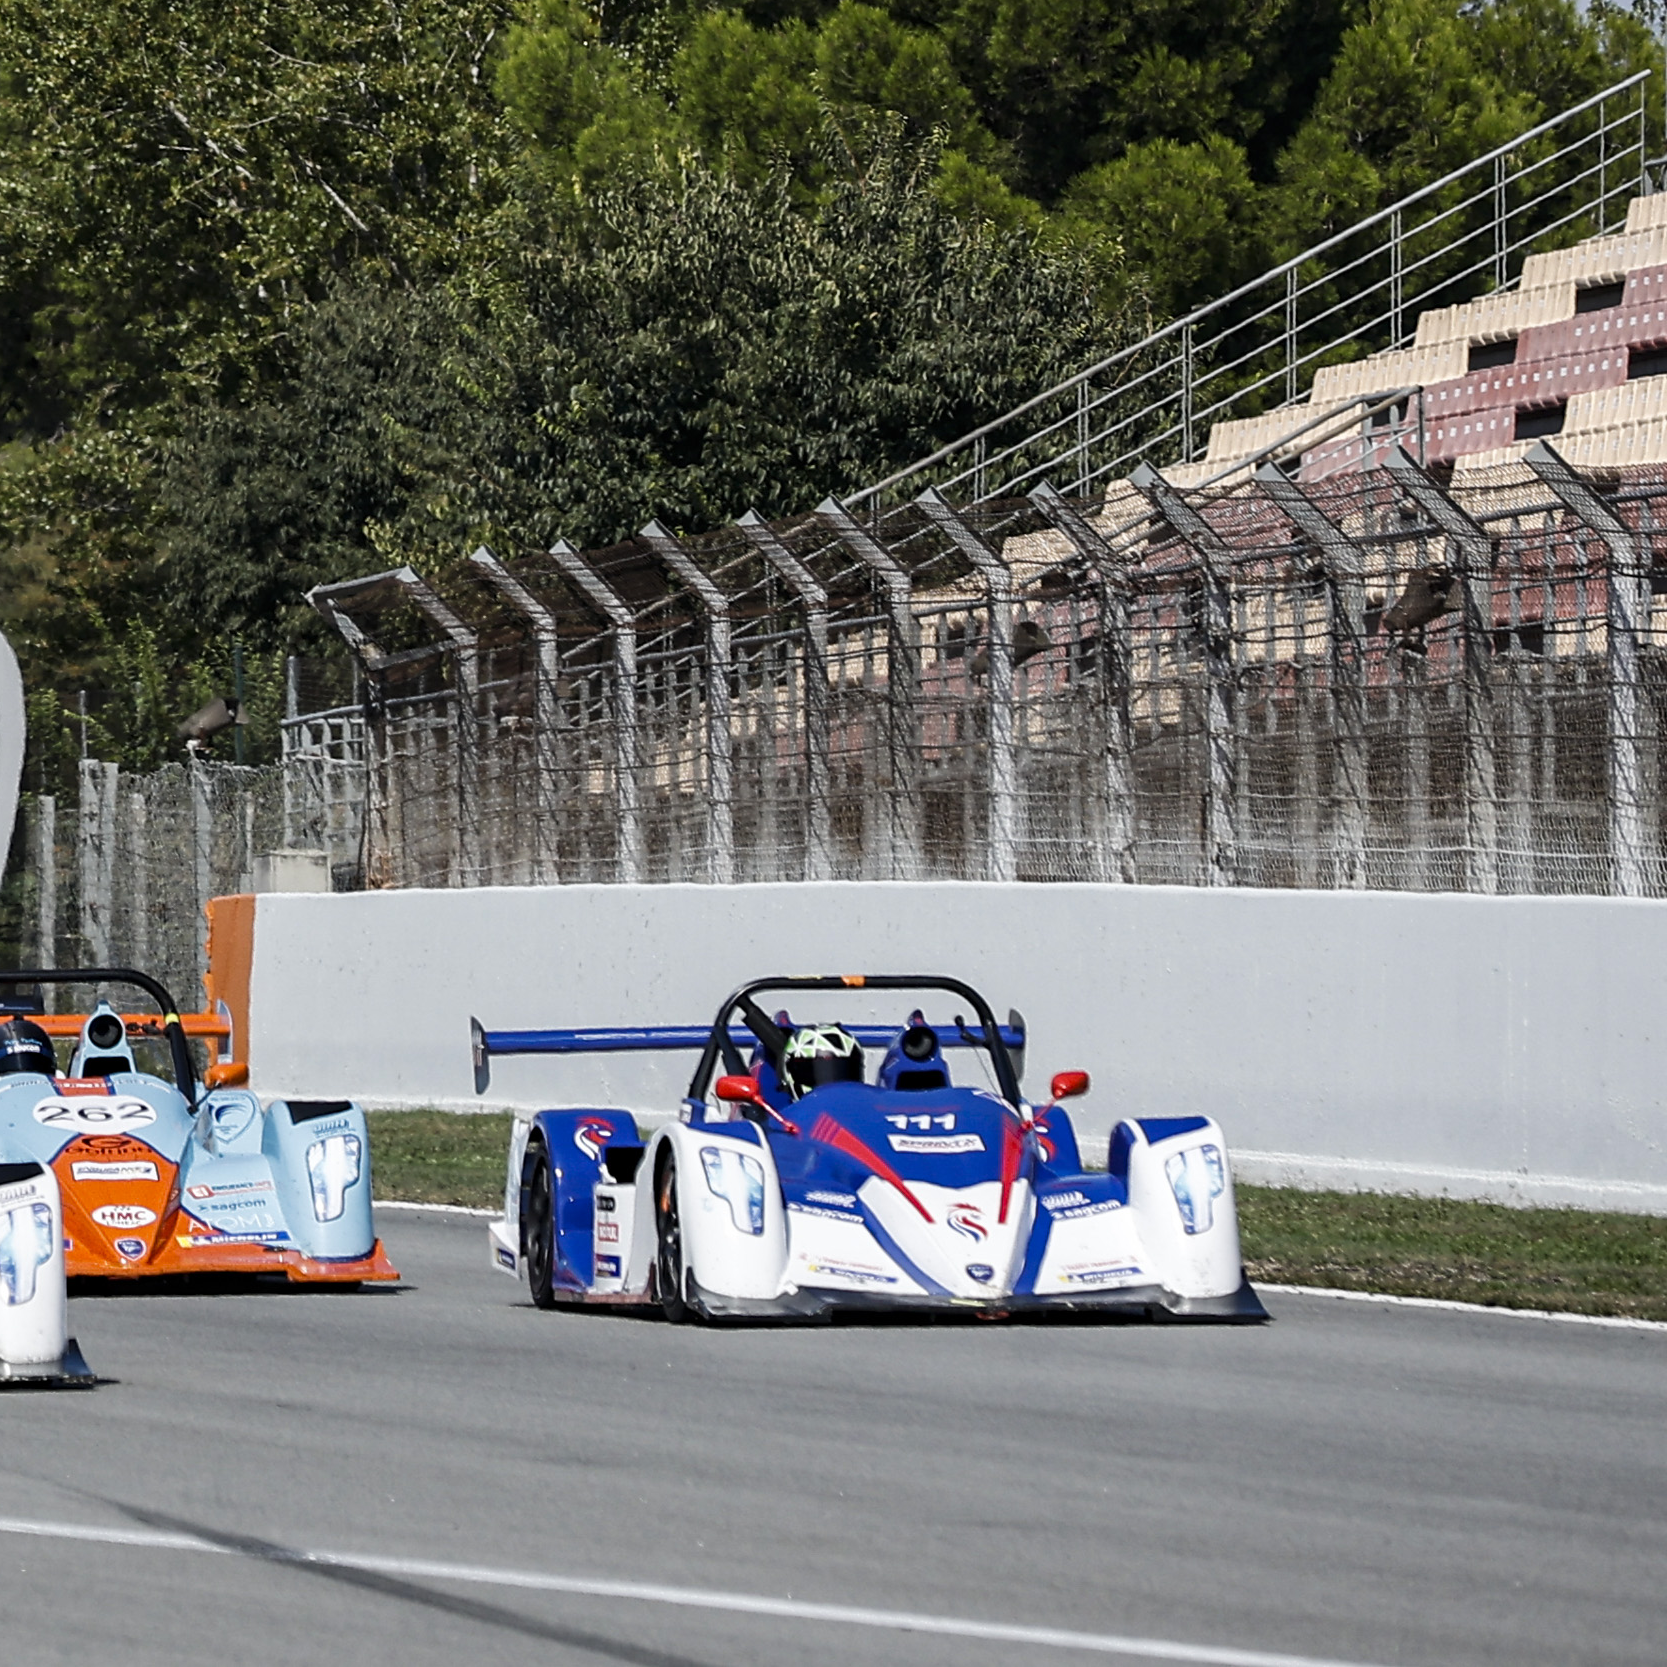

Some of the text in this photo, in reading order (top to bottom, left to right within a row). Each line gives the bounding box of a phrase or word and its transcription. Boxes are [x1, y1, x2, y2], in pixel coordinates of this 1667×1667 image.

[37, 1103, 155, 1123] 262
[211, 1200, 266, 1212] sagcom
[101, 1212, 146, 1221] HMC
[212, 1234, 277, 1243] MICHELIN
